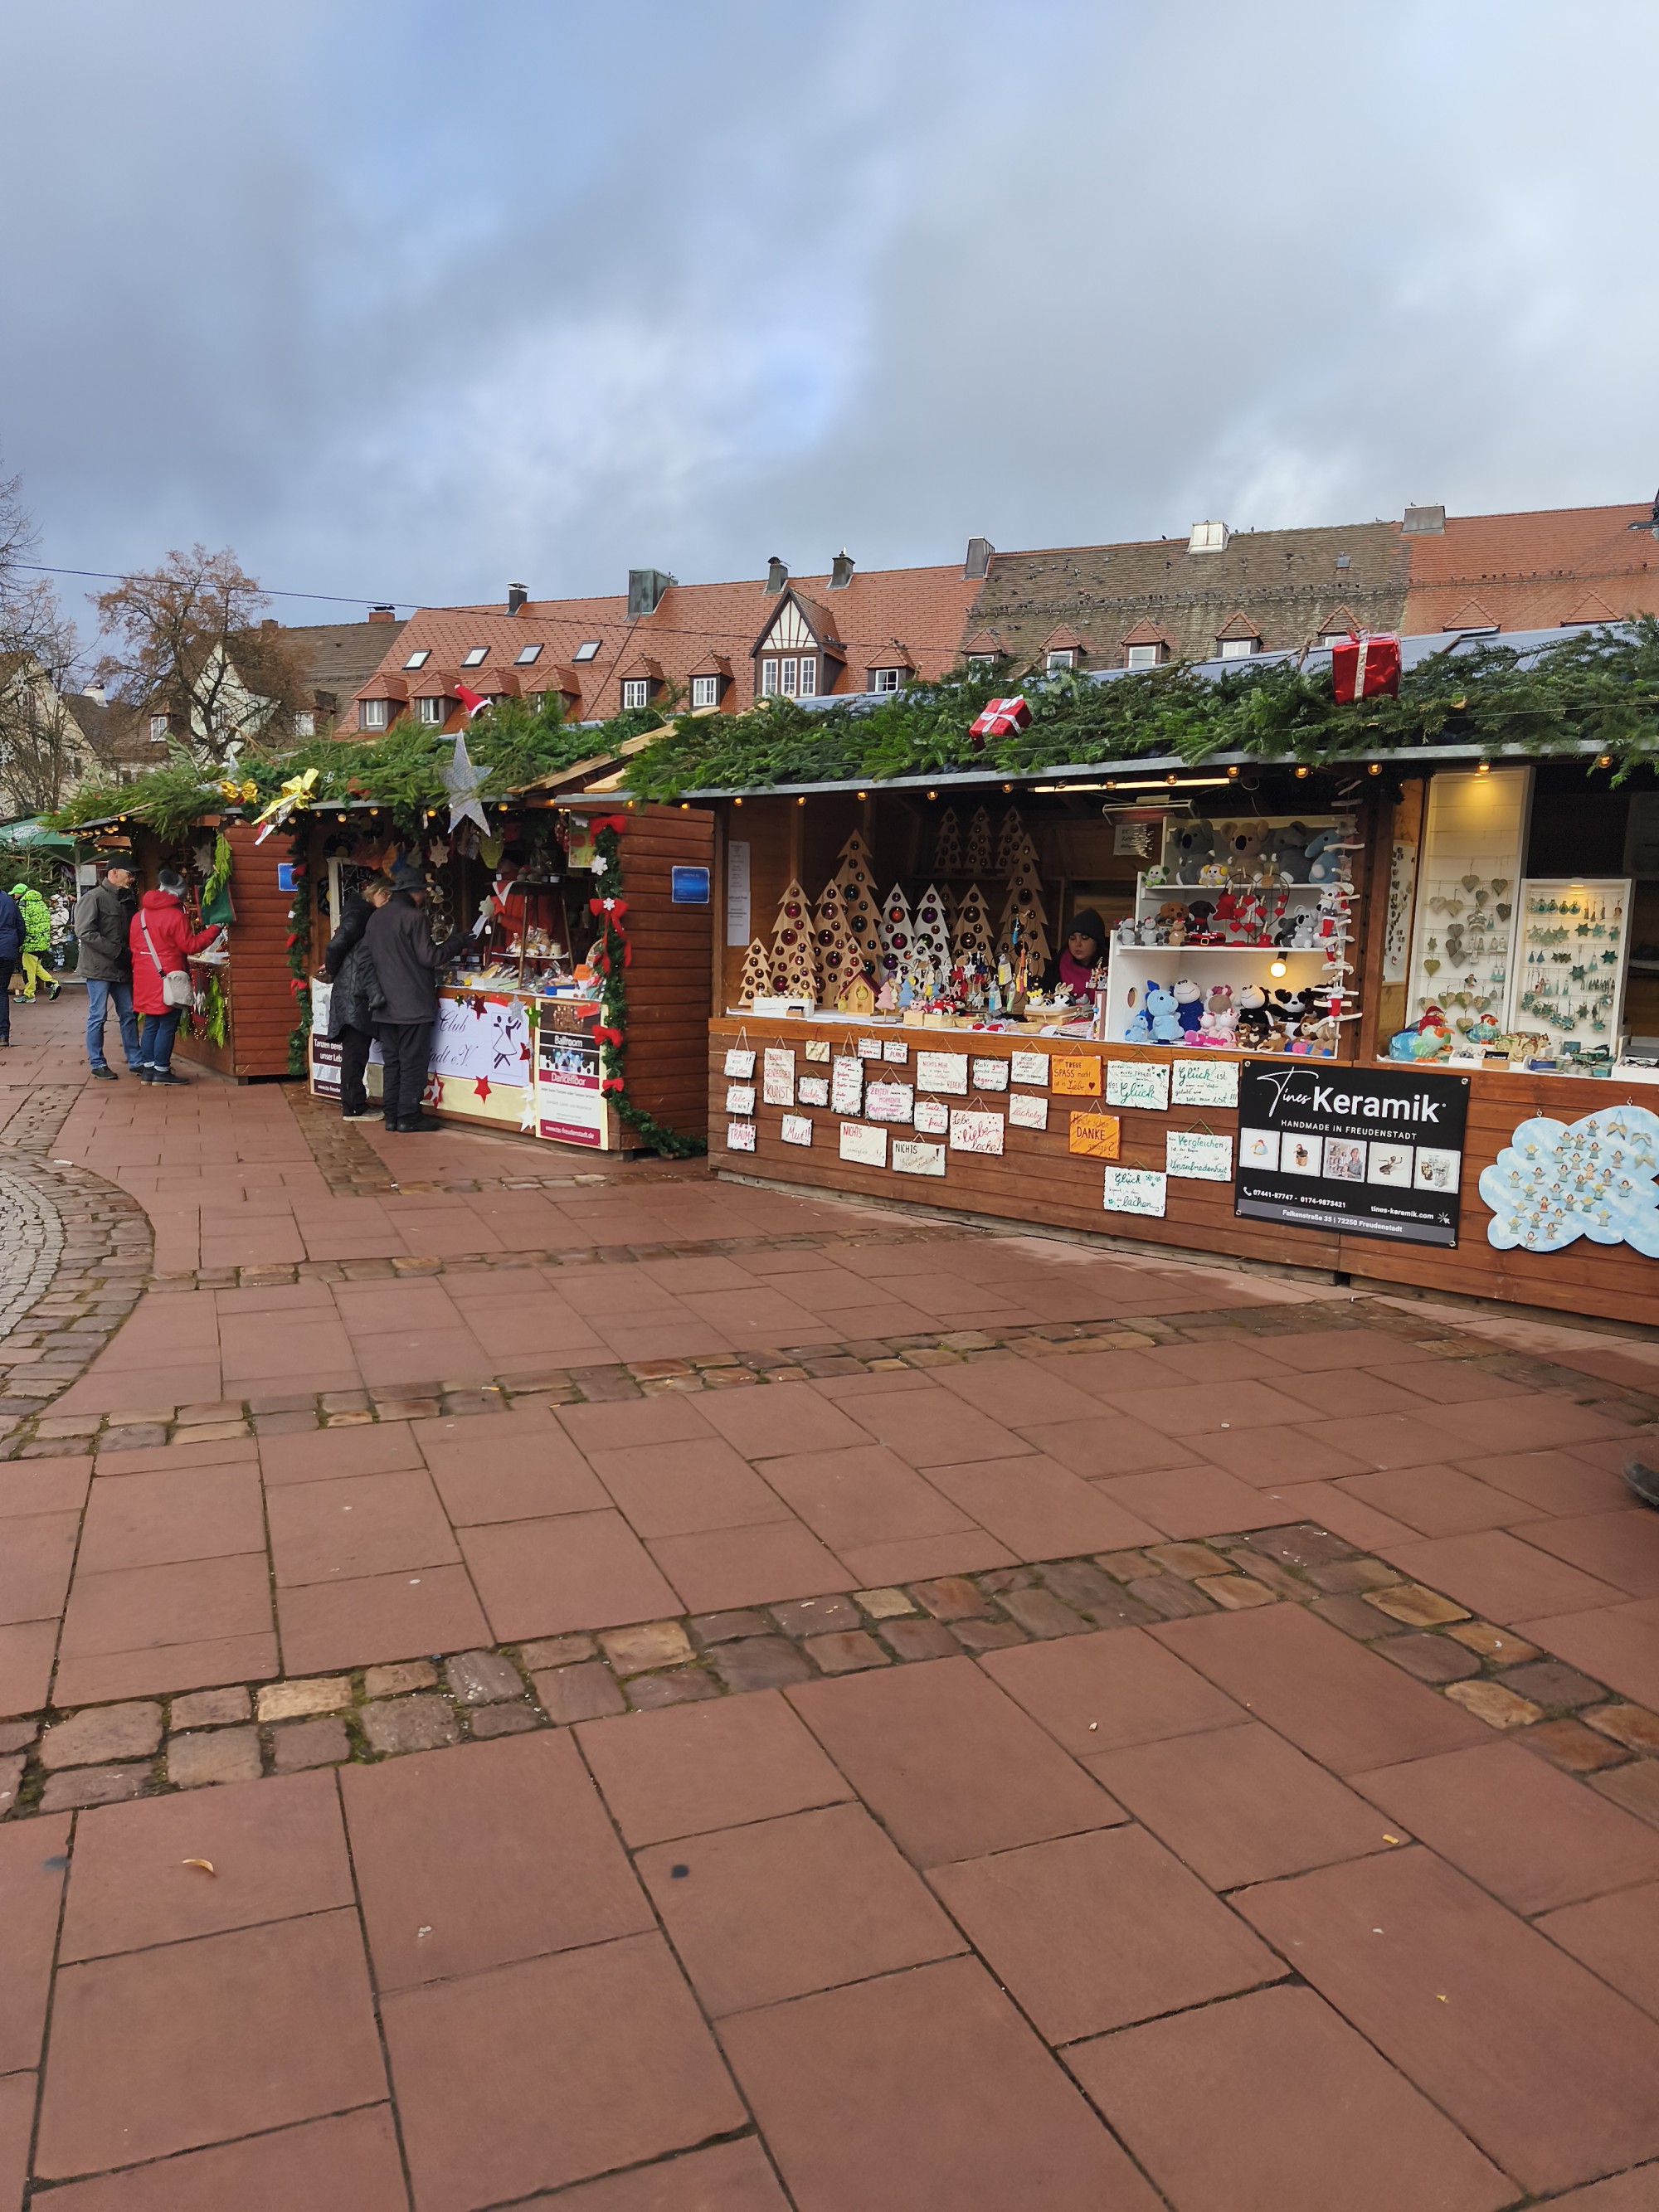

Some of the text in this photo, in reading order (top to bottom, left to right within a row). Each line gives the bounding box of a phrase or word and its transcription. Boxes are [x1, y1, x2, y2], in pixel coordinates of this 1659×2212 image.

[440, 1009, 469, 1033] Club
[314, 1038, 331, 1049] Tanzen
[554, 1035, 583, 1048] Ballroom
[319, 1053, 343, 1062] unser Leb
[551, 1072, 586, 1087] Dancefloor
[1053, 1069, 1075, 1078] SPASS
[1178, 1067, 1215, 1087] Glück
[766, 1087, 790, 1099] KUNST
[1120, 1082, 1155, 1104] Glück
[1257, 1066, 1440, 1123] Tines Keramik
[843, 1125, 863, 1139] NICHTS
[1077, 1126, 1106, 1140] DANKE
[1281, 1120, 1418, 1141] HANDMADE IN FREUDENSTADT
[895, 1143, 917, 1155] NICHTS
[1114, 1172, 1141, 1187] Glück
[1370, 1205, 1434, 1220] tines-keramik.com
[1282, 1208, 1323, 1222] Falkenstraße
[1324, 1215, 1332, 1223] 35
[1337, 1217, 1358, 1227] 72250
[1359, 1220, 1403, 1233] Freudenstadt
